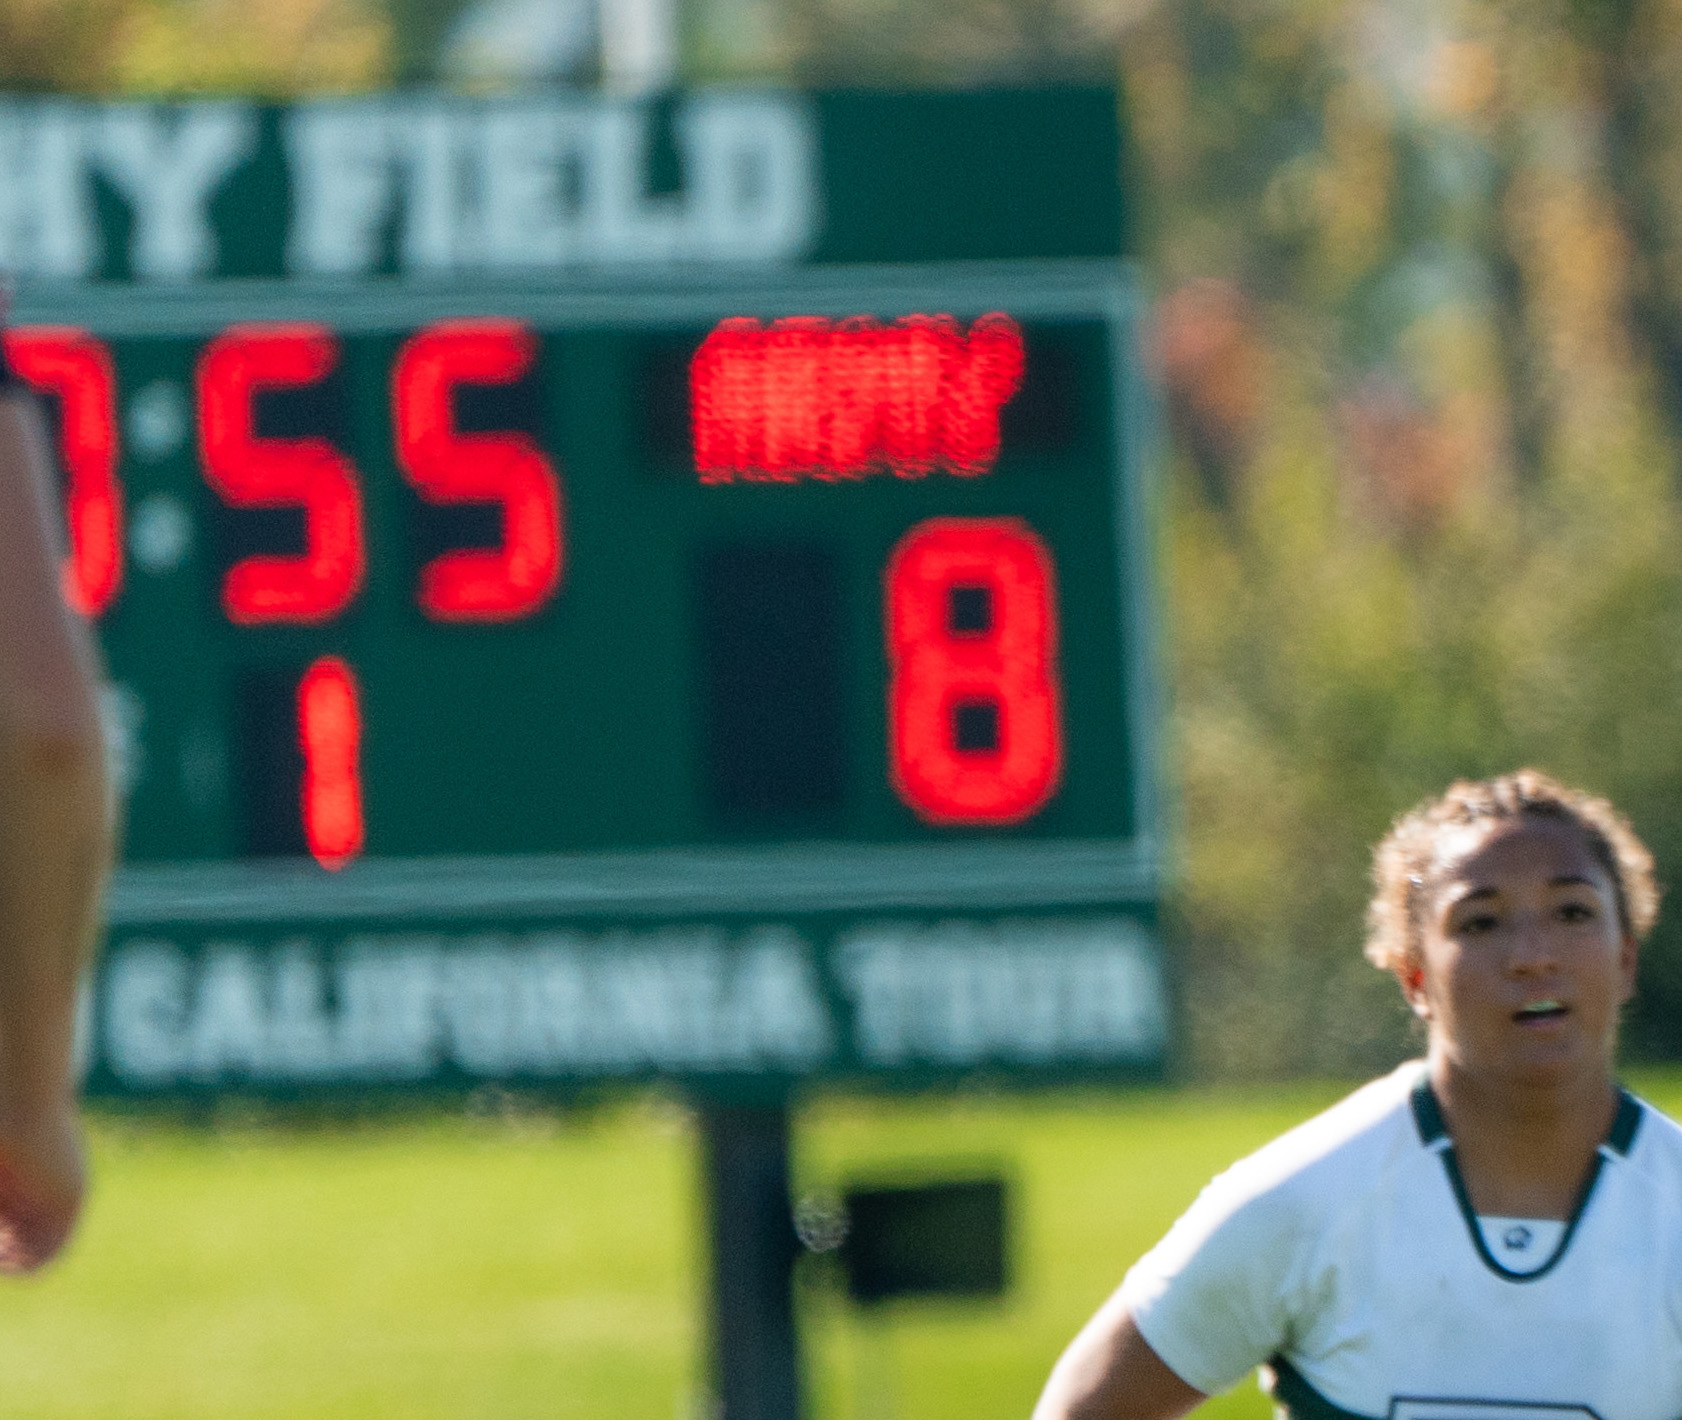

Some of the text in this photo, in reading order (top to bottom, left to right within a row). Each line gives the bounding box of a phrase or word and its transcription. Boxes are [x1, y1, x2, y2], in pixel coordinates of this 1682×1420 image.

[284, 98, 815, 270] FIELD
[297, 654, 365, 872] 1
[884, 516, 1062, 826] 8
[103, 917, 1167, 1085] CALIFORNIA TOUR
